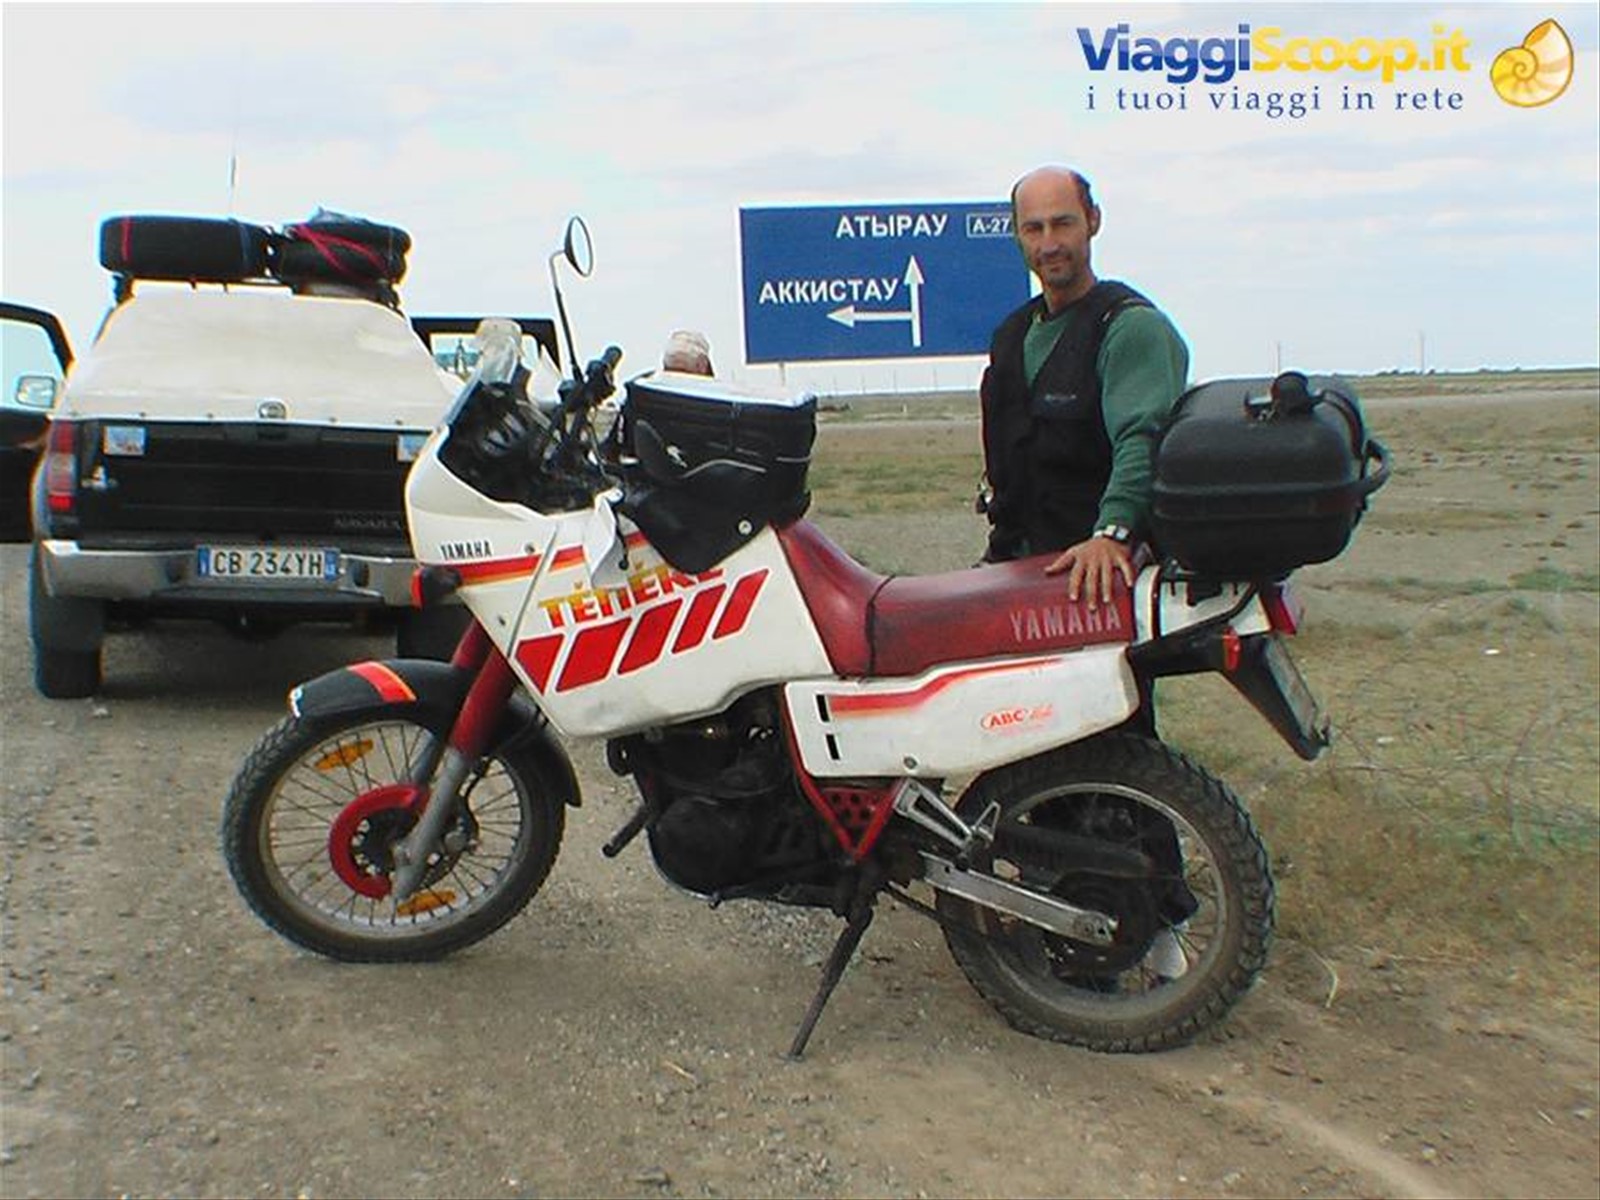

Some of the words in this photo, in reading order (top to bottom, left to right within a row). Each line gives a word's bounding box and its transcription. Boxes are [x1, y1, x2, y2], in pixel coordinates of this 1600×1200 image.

[835, 213, 948, 239] АТЫРАУ
[758, 278, 899, 305] АККИСТАУ
[440, 540, 493, 561] YAMAHA
[214, 552, 243, 575] CB
[249, 552, 323, 575] 234YH
[1009, 602, 1122, 643] YAMAHA
[988, 708, 1025, 729] ABC
